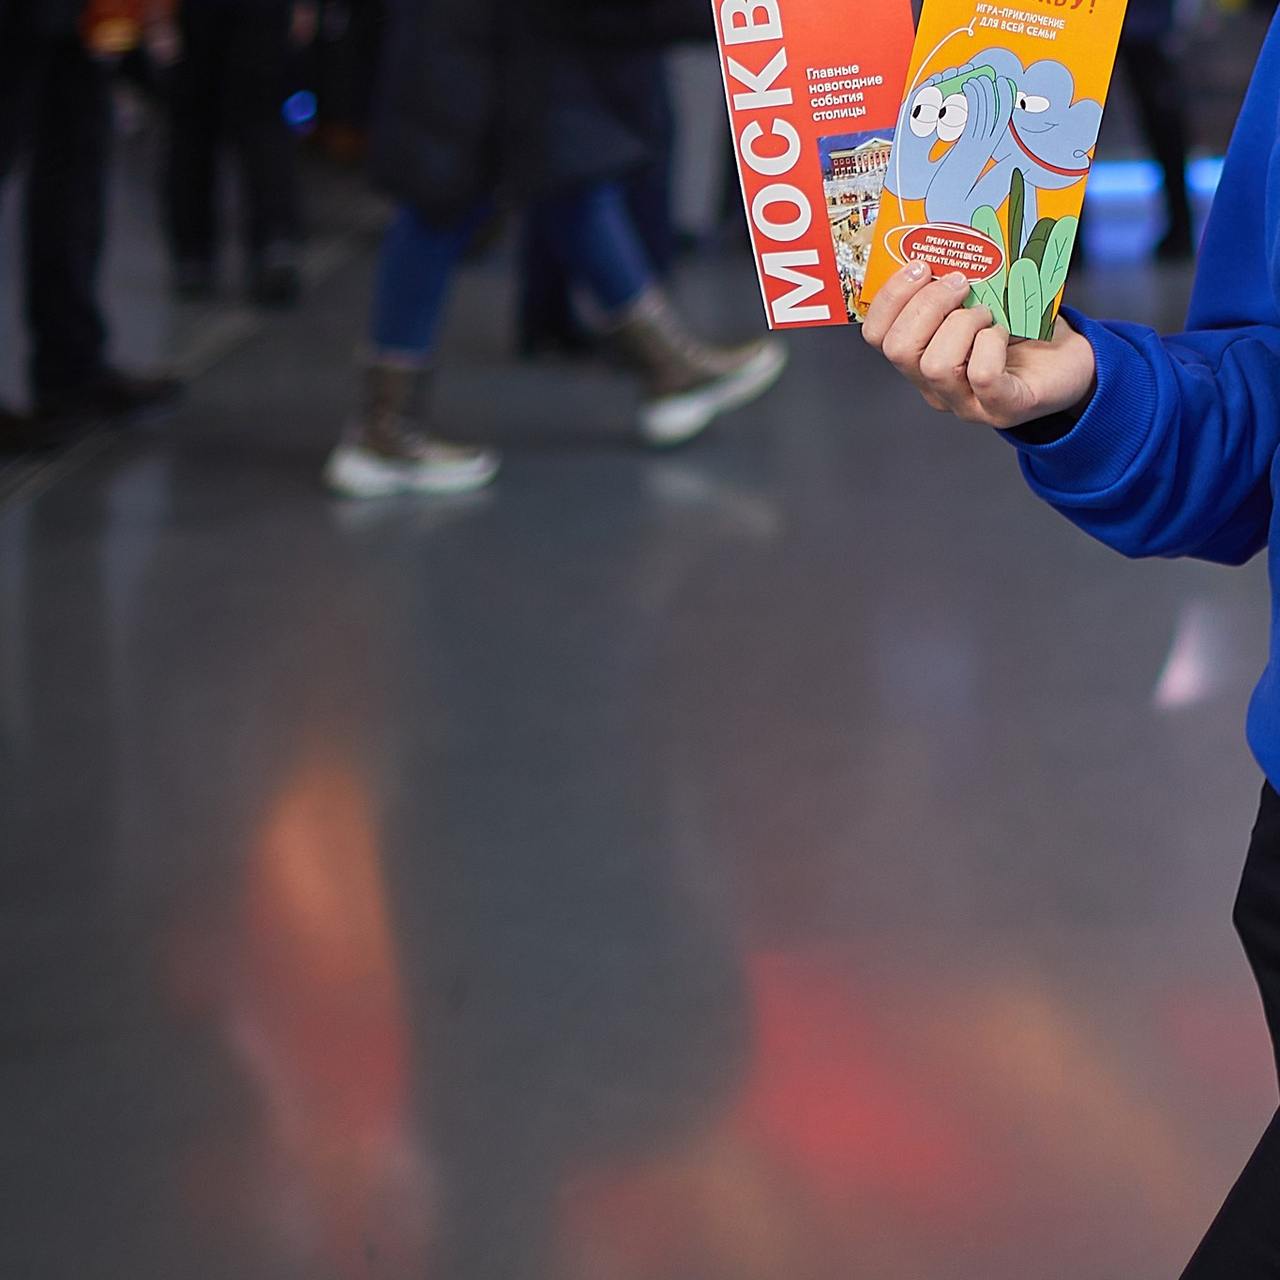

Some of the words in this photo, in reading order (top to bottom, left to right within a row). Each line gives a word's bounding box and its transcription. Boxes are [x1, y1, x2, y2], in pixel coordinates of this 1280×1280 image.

[976, 2, 1066, 30] ИГРА-ПРИКЛЮЧЕНИЕ
[979, 16, 999, 29] ДЛЯ
[1001, 19, 1024, 34] ВСЕЙ
[1026, 25, 1058, 41] СЕМЬИ
[806, 64, 860, 80] Главные
[808, 75, 883, 94] новогодние
[810, 92, 864, 108] события
[812, 106, 867, 122] столицы
